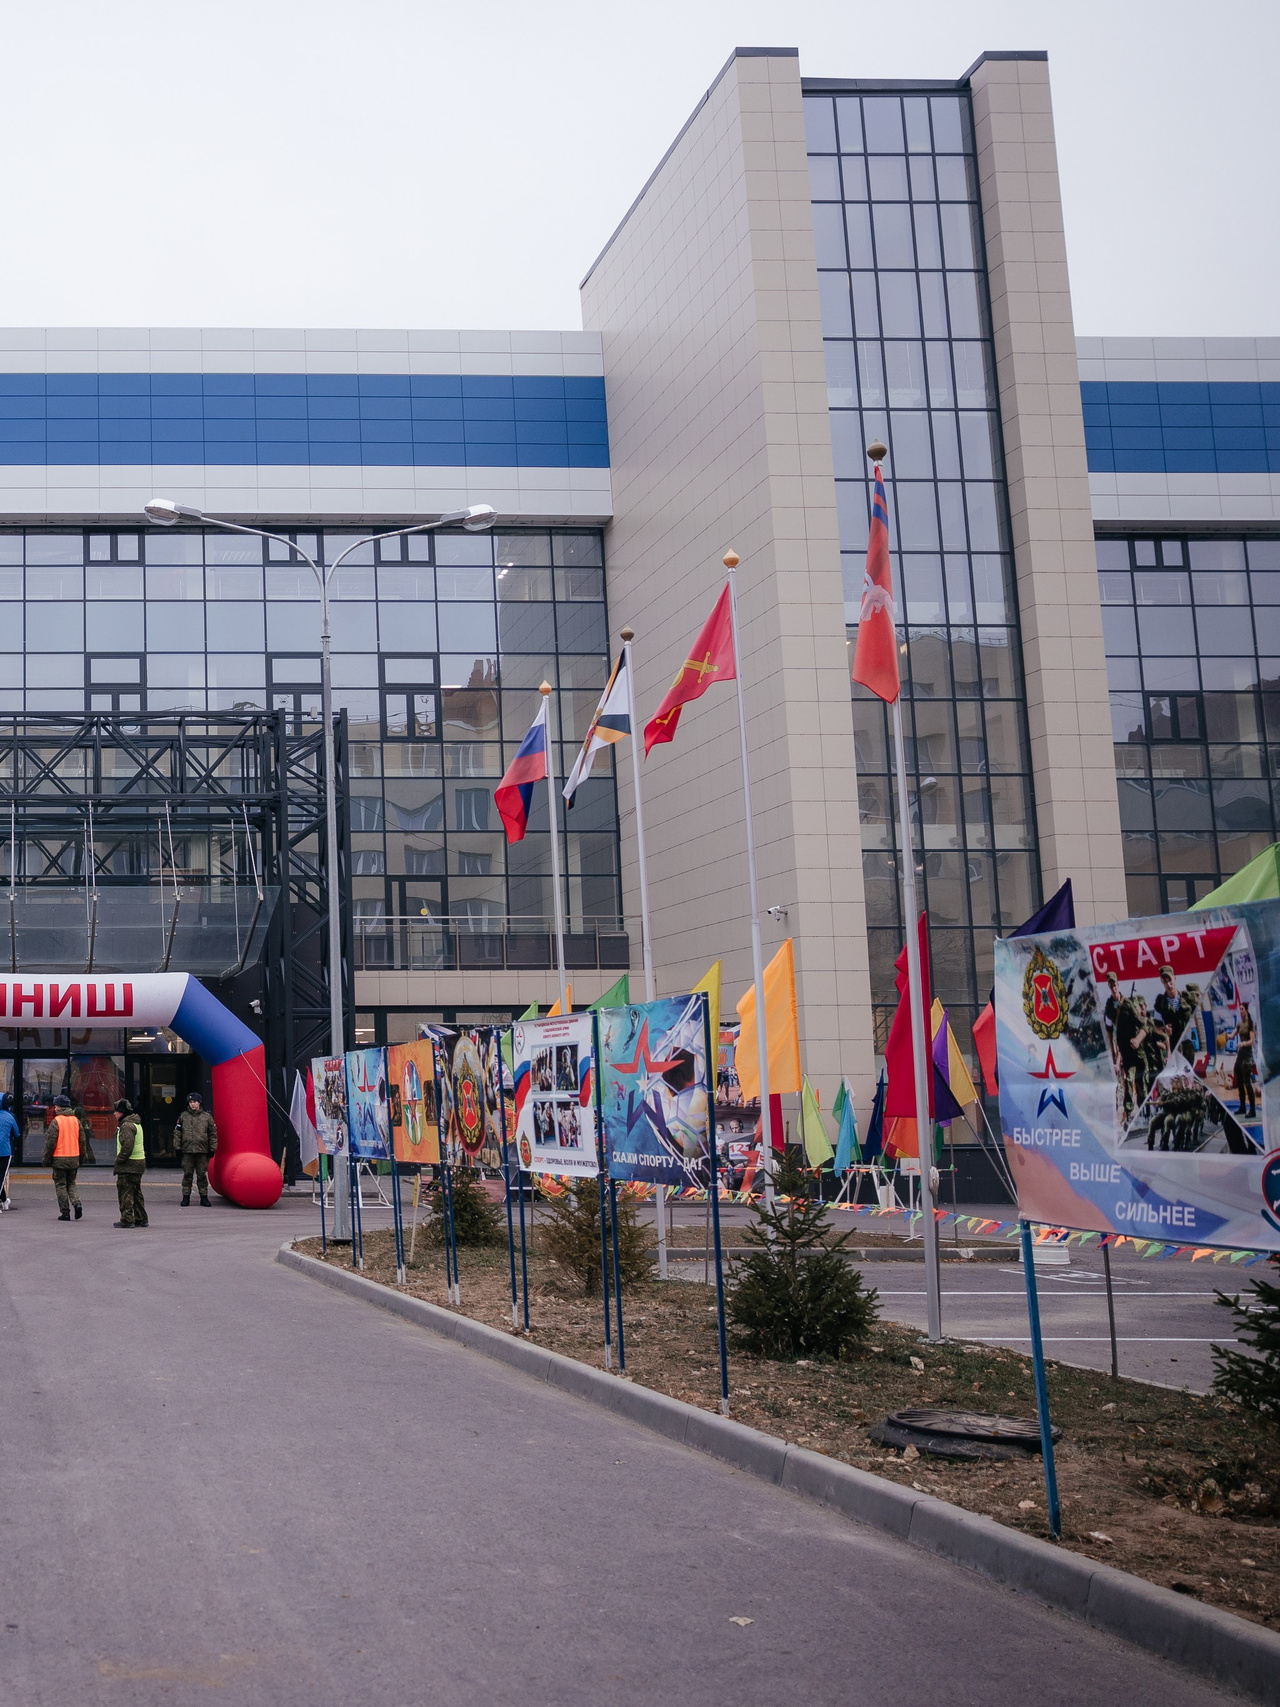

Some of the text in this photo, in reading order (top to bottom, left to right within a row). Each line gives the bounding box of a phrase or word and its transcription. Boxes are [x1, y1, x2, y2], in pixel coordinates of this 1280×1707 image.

[1091, 929, 1207, 974] СТАРТ
[1013, 1127, 1081, 1147] БЫСТРЕЕ
[612, 1151, 638, 1164] СКАЖИ
[639, 1153, 674, 1168] СПОРТУ
[1069, 1163, 1122, 1184] ВЫШЕ
[1114, 1200, 1196, 1228] СИЛЬНЕЕ
